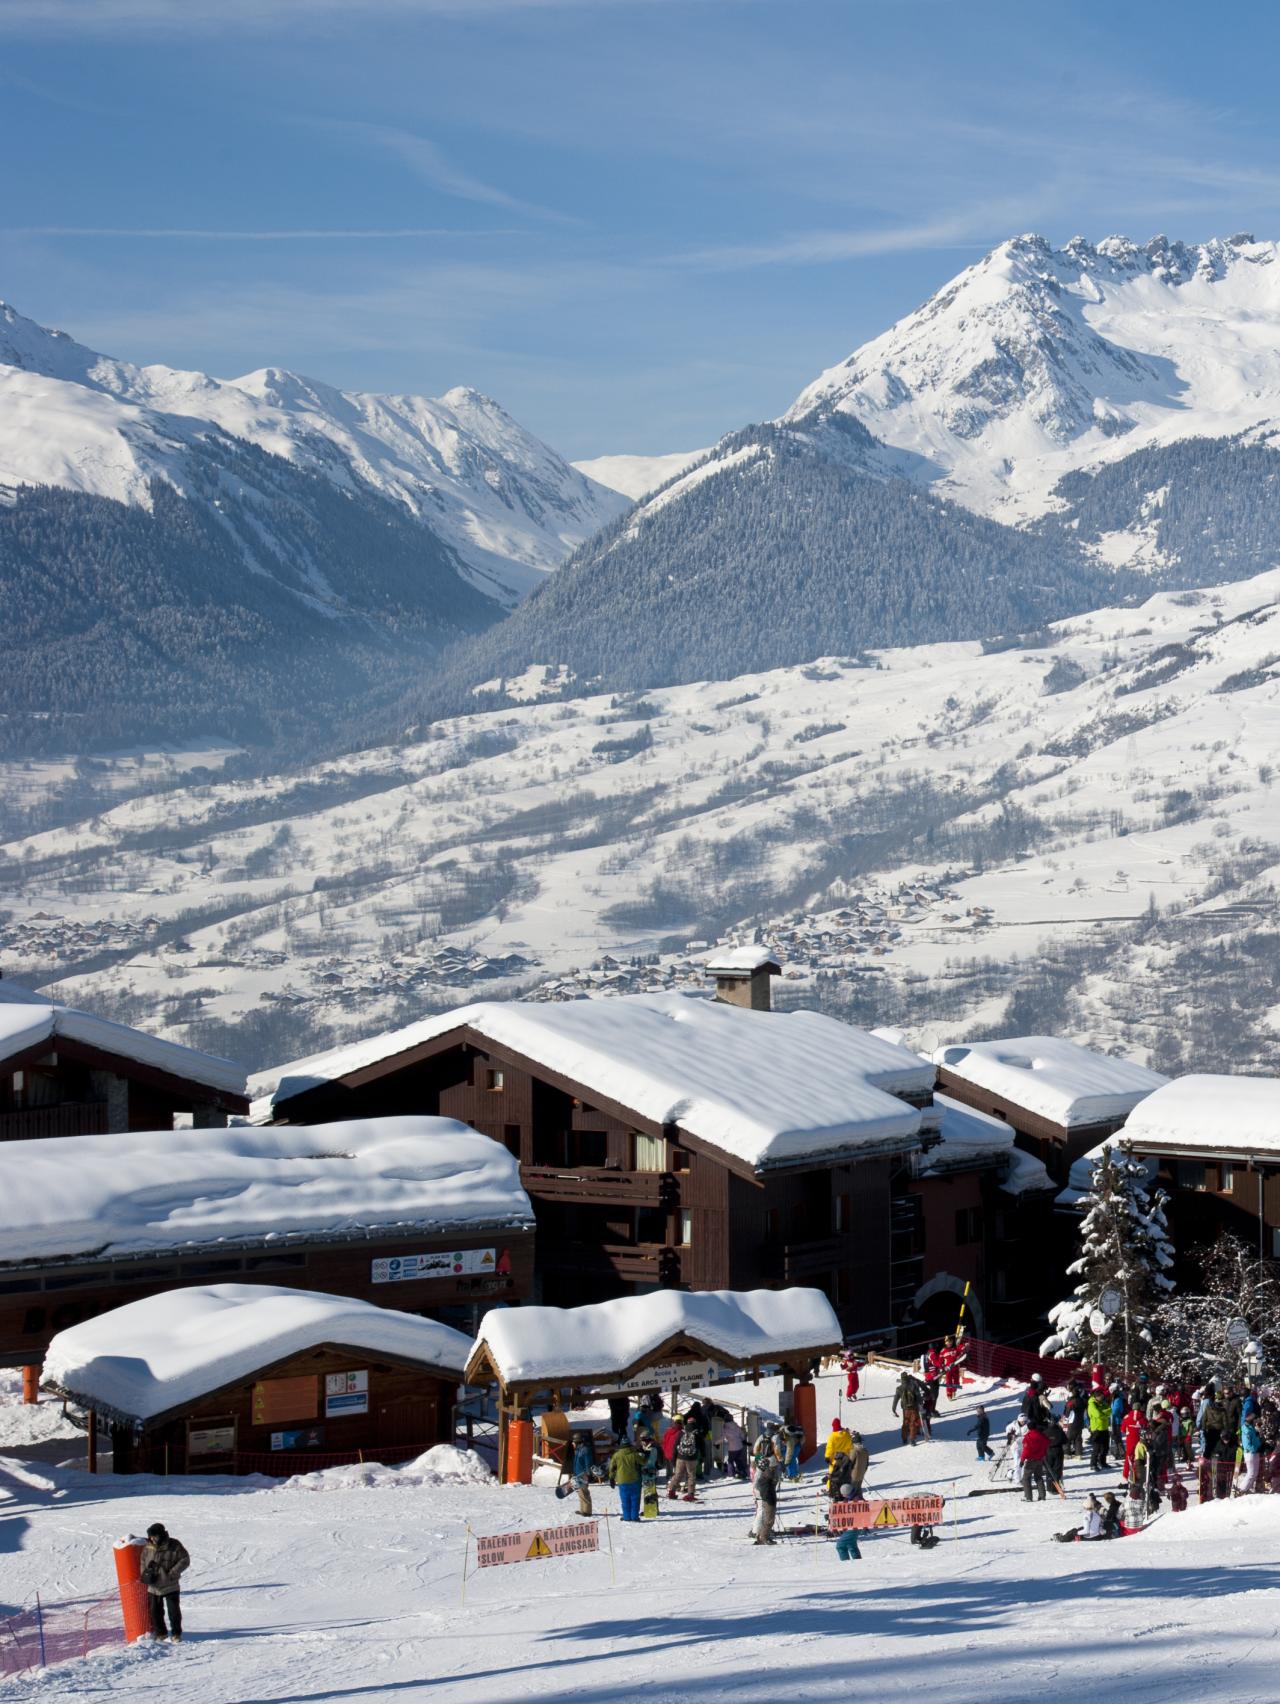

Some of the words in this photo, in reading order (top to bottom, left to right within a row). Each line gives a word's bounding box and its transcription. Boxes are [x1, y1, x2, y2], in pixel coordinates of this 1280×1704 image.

[641, 1379, 658, 1387] ARCS
[680, 1374, 704, 1382] PLAGNE
[832, 1503, 870, 1515] RALENTIR
[891, 1499, 940, 1511] RALLENTARE
[832, 1517, 854, 1527] SLOW
[901, 1512, 940, 1523] LANGSAM
[480, 1535, 521, 1550] RALENTIR
[543, 1524, 594, 1541] RALLENTARE
[481, 1551, 505, 1564] SLOW
[555, 1538, 596, 1553] LANGSAM
